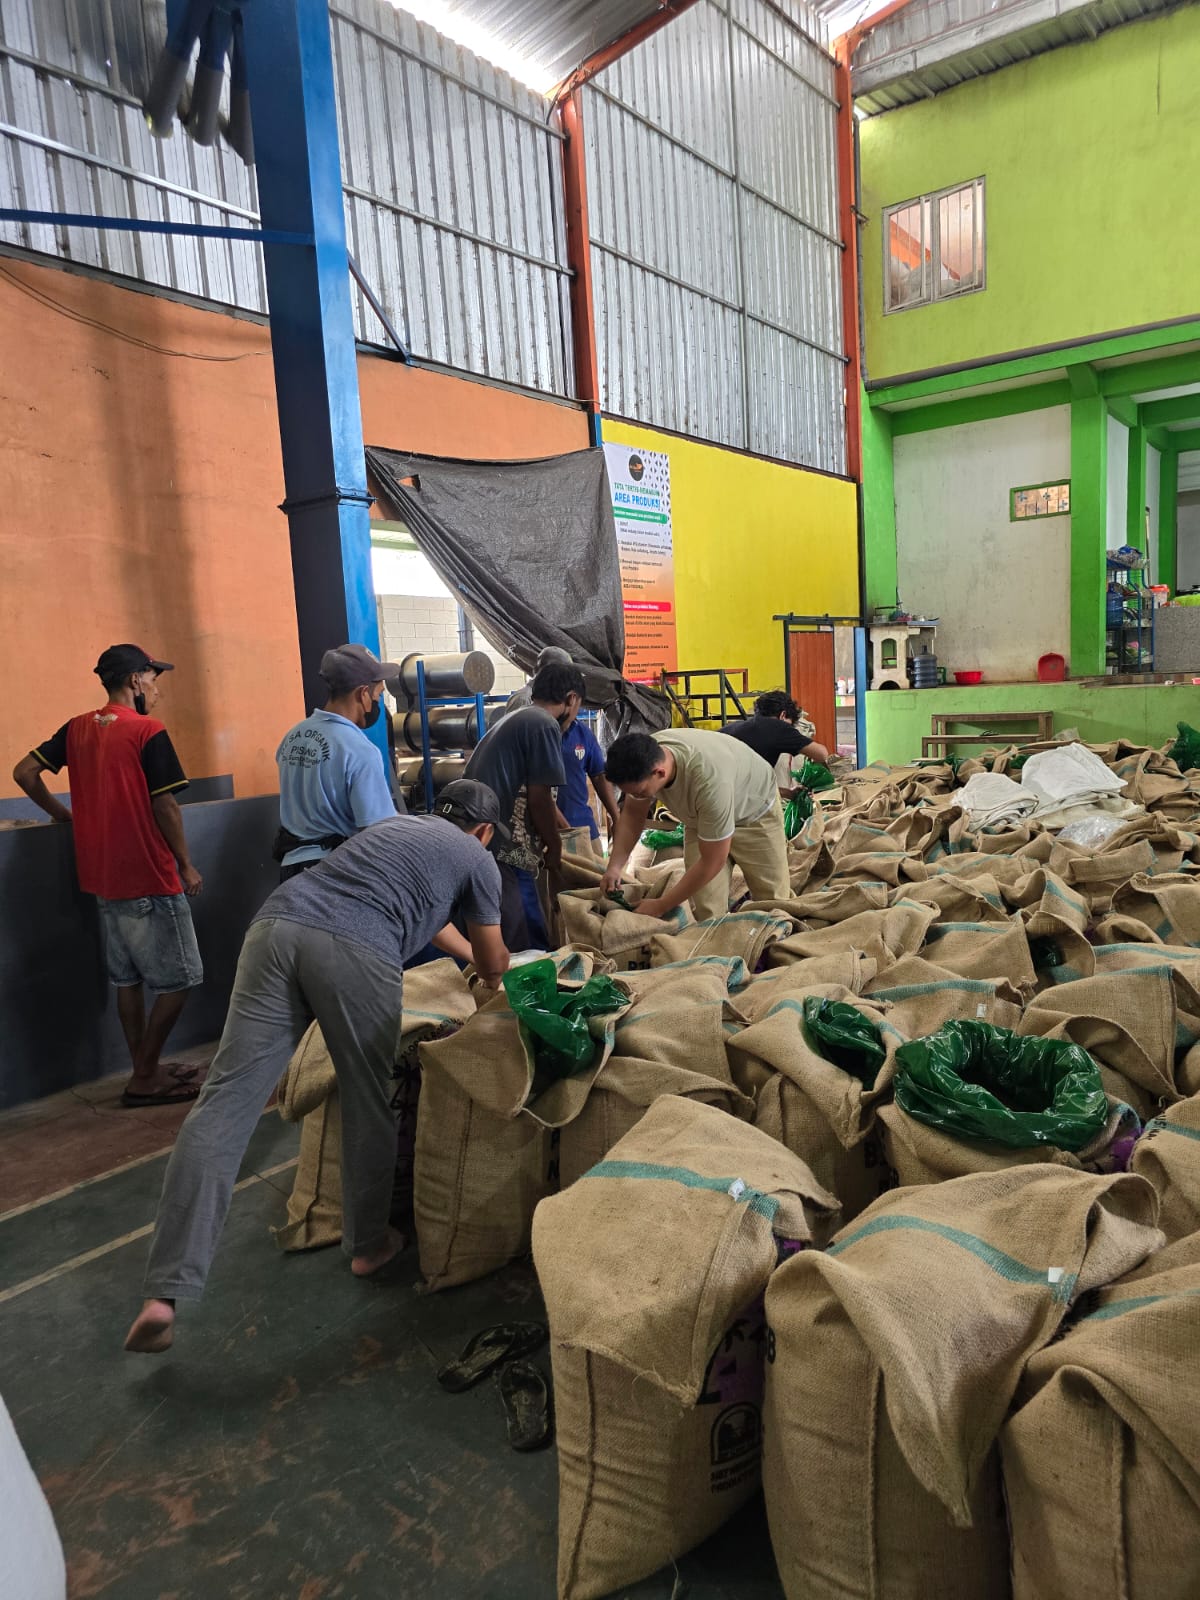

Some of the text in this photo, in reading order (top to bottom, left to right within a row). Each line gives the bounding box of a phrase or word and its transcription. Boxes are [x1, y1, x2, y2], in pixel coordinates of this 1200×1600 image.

[614, 492, 661, 509] AREA PRODUKSI
[304, 729, 331, 762] ORGANIK
